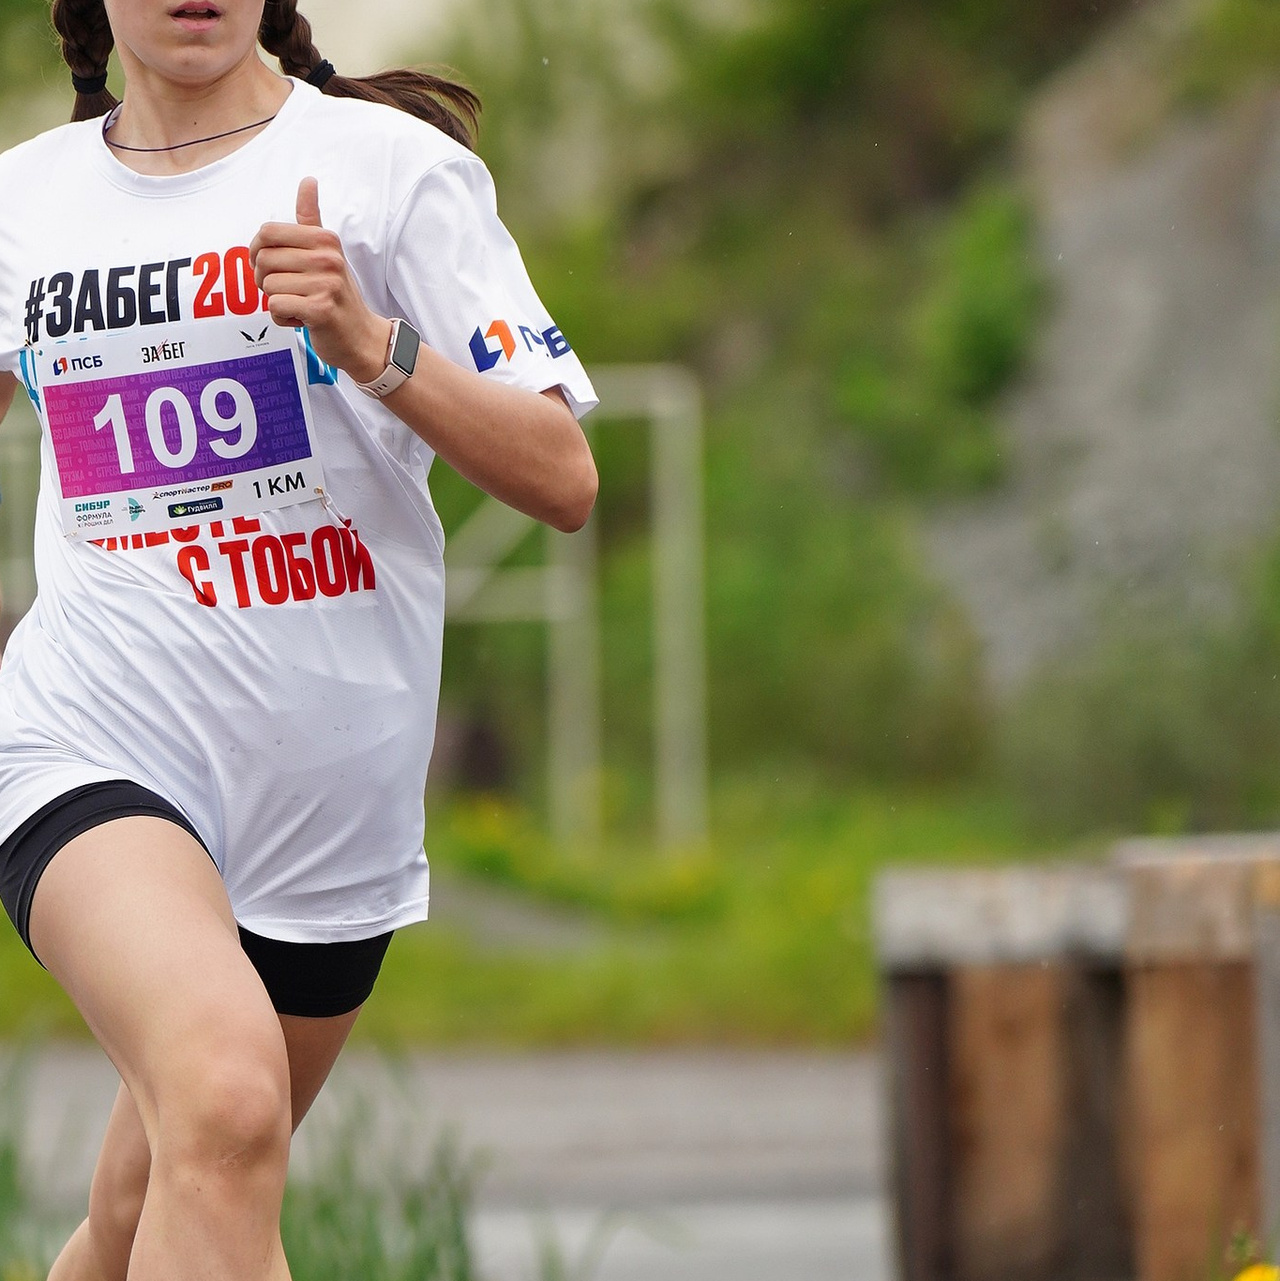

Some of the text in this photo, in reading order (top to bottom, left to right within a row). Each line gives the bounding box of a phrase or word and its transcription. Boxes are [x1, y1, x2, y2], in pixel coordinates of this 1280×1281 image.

[24, 246, 272, 344] #ЗАБЕГ20
[71, 355, 103, 371] ПСБ
[93, 378, 257, 474] 109
[252, 471, 306, 499] 1 КМ
[75, 500, 110, 512] СИБУР
[76, 512, 112, 522] ФОРМУЛА
[177, 545, 218, 608] С
[218, 518, 376, 609] ТОБОЙ
